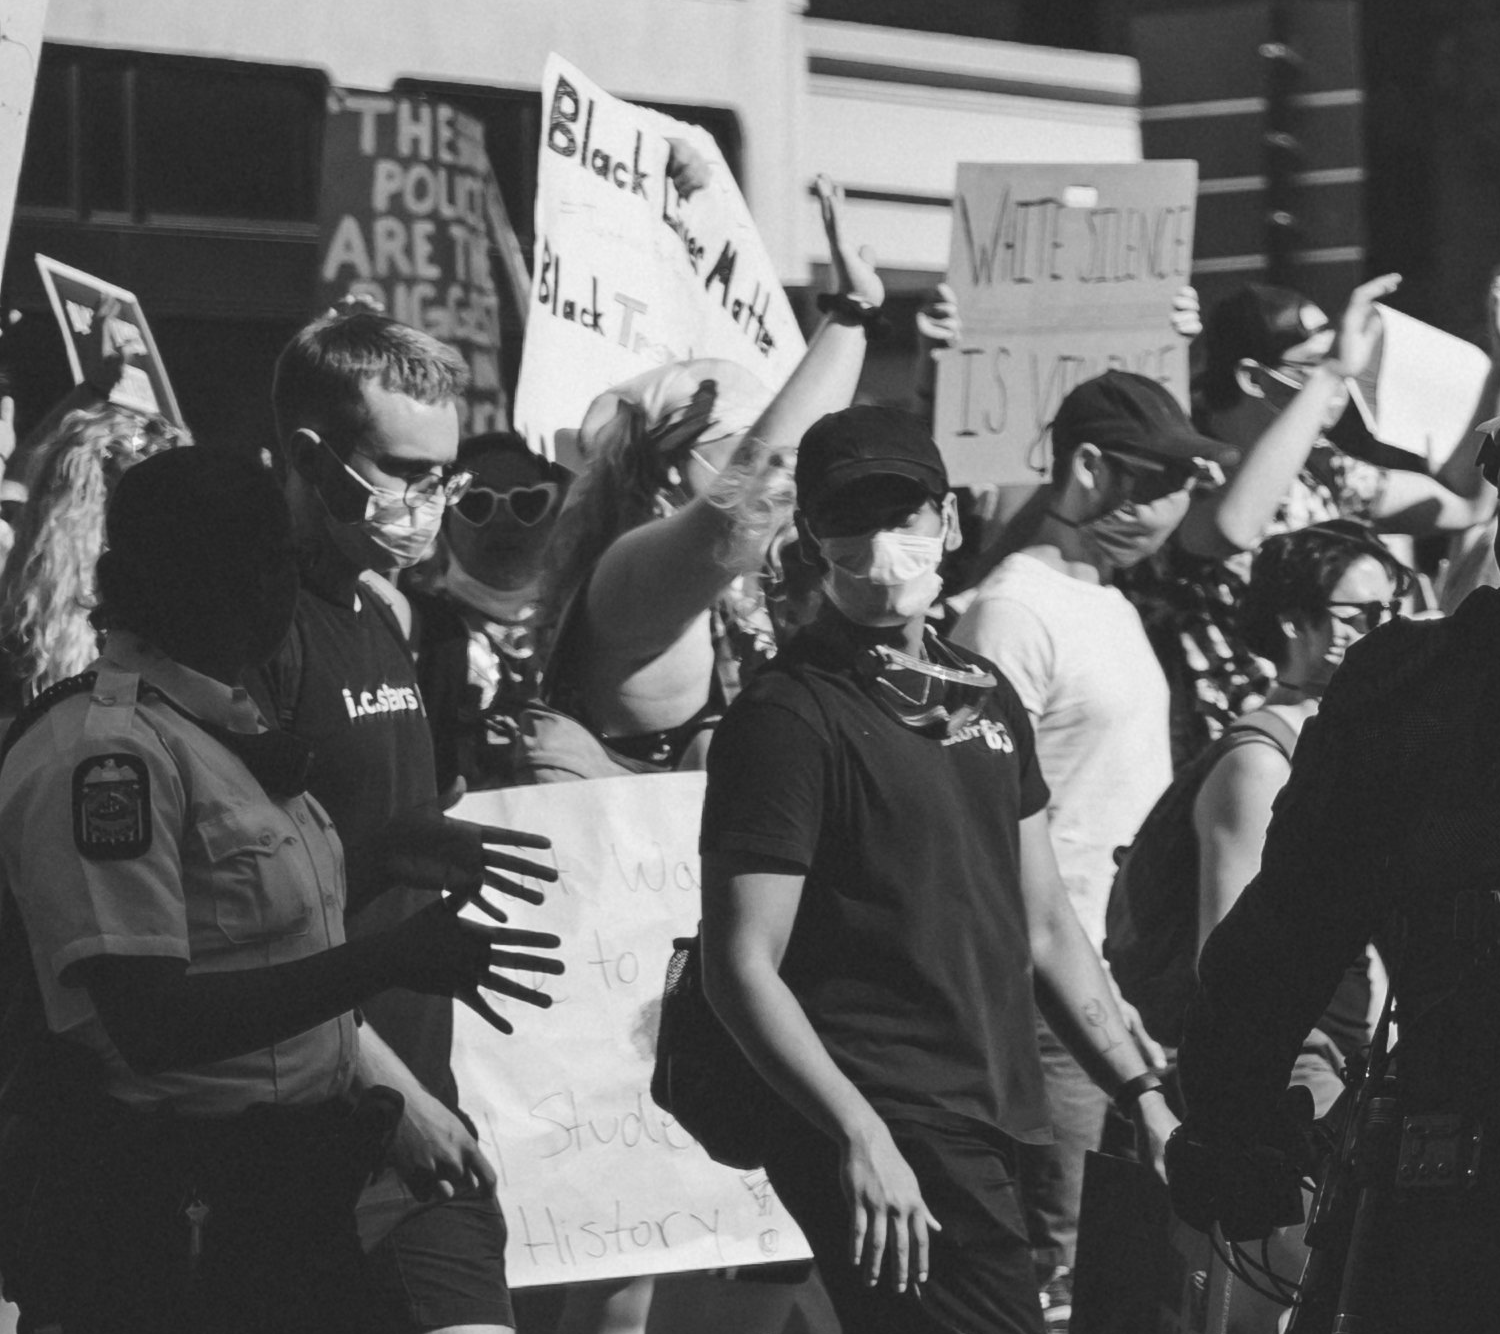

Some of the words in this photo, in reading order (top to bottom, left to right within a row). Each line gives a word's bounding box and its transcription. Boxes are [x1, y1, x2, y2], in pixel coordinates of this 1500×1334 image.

[547, 73, 650, 201] Black
[322, 215, 441, 282] ARE
[538, 234, 605, 337] Black
[956, 346, 1012, 437] IS
[587, 928, 639, 990] to
[529, 1090, 699, 1160] Stude
[519, 1199, 723, 1267] History
